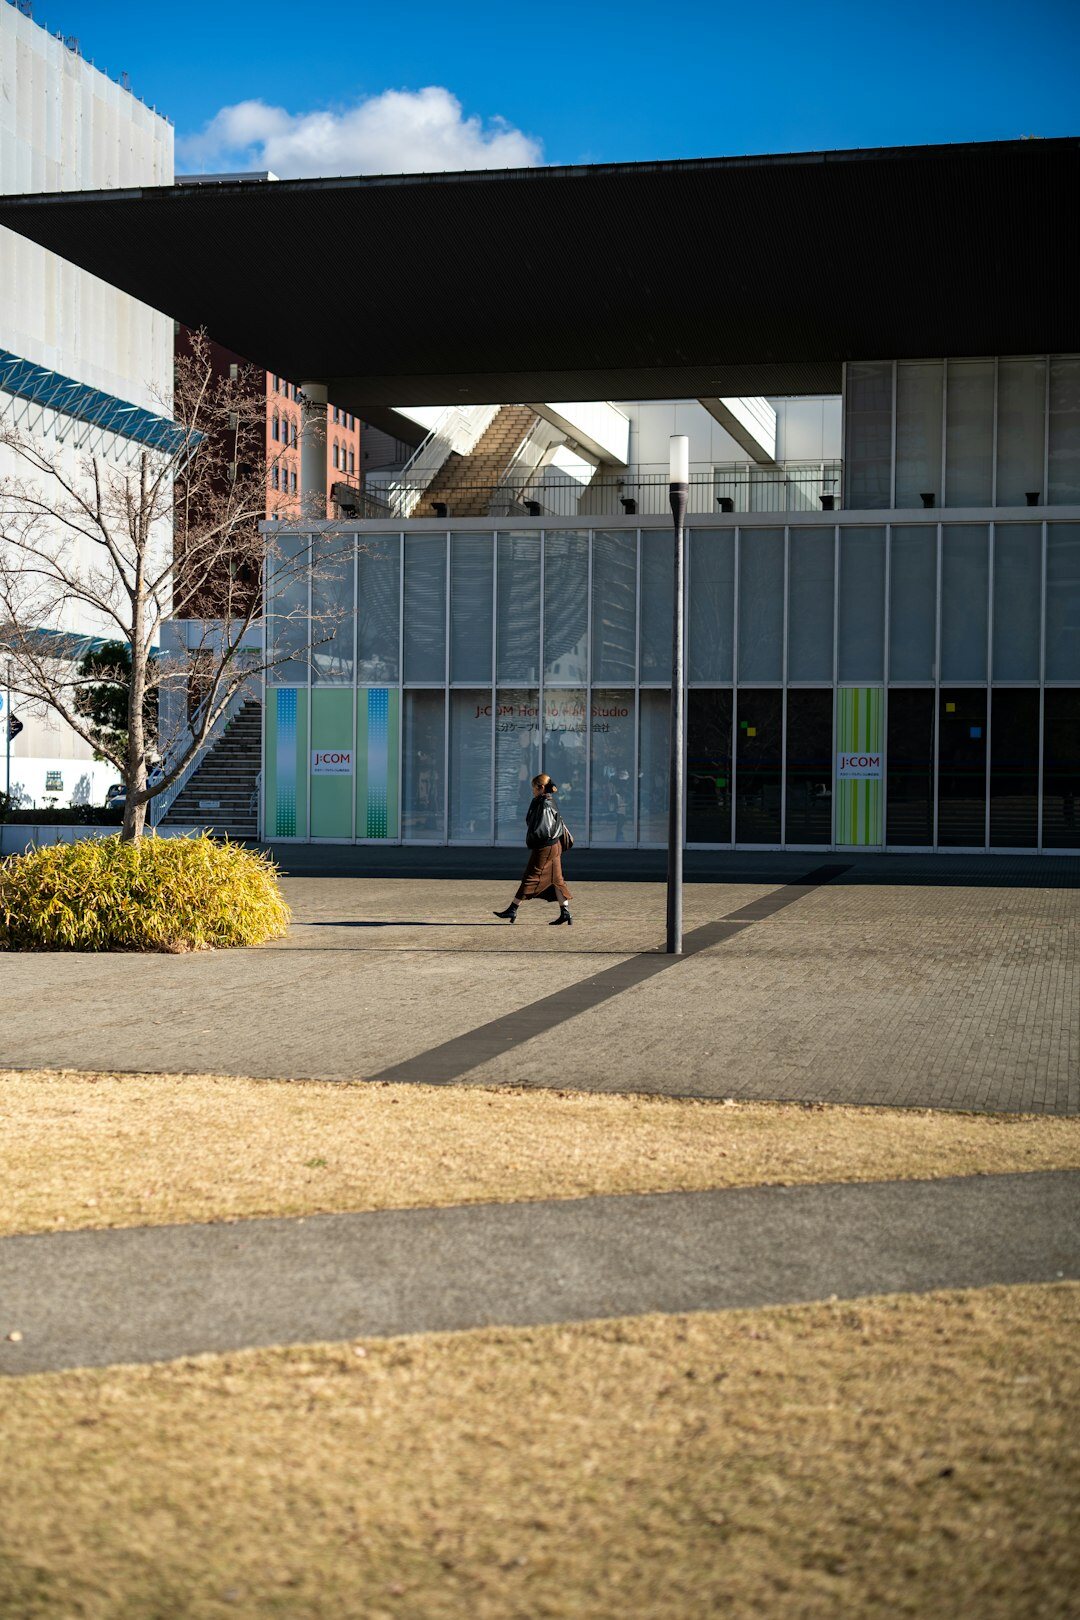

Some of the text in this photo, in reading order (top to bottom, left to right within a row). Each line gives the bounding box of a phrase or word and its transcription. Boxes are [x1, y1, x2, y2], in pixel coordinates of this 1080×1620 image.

[474, 705, 514, 719] J:COM
[591, 705, 629, 717] Studio
[314, 753, 350, 766] J:COM
[840, 756, 880, 770] J:COM
